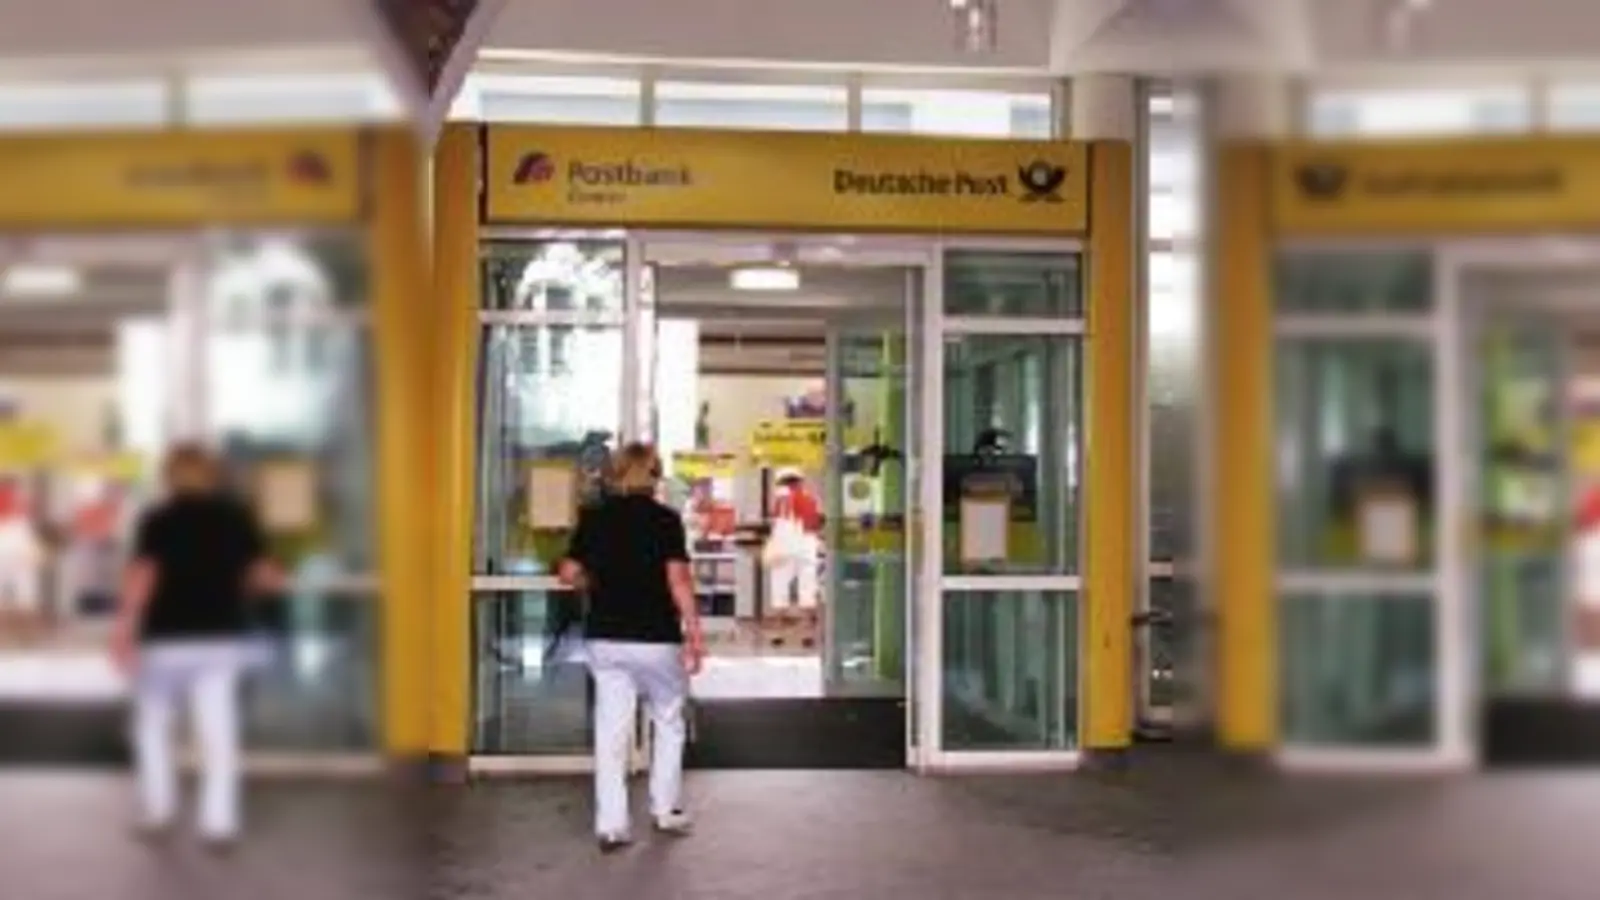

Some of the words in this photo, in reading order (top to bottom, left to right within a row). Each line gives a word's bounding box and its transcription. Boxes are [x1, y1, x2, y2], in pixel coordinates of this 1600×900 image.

[568, 160, 692, 186] Postbank
[834, 168, 951, 194] Deutsche
[955, 170, 1008, 195] Post
